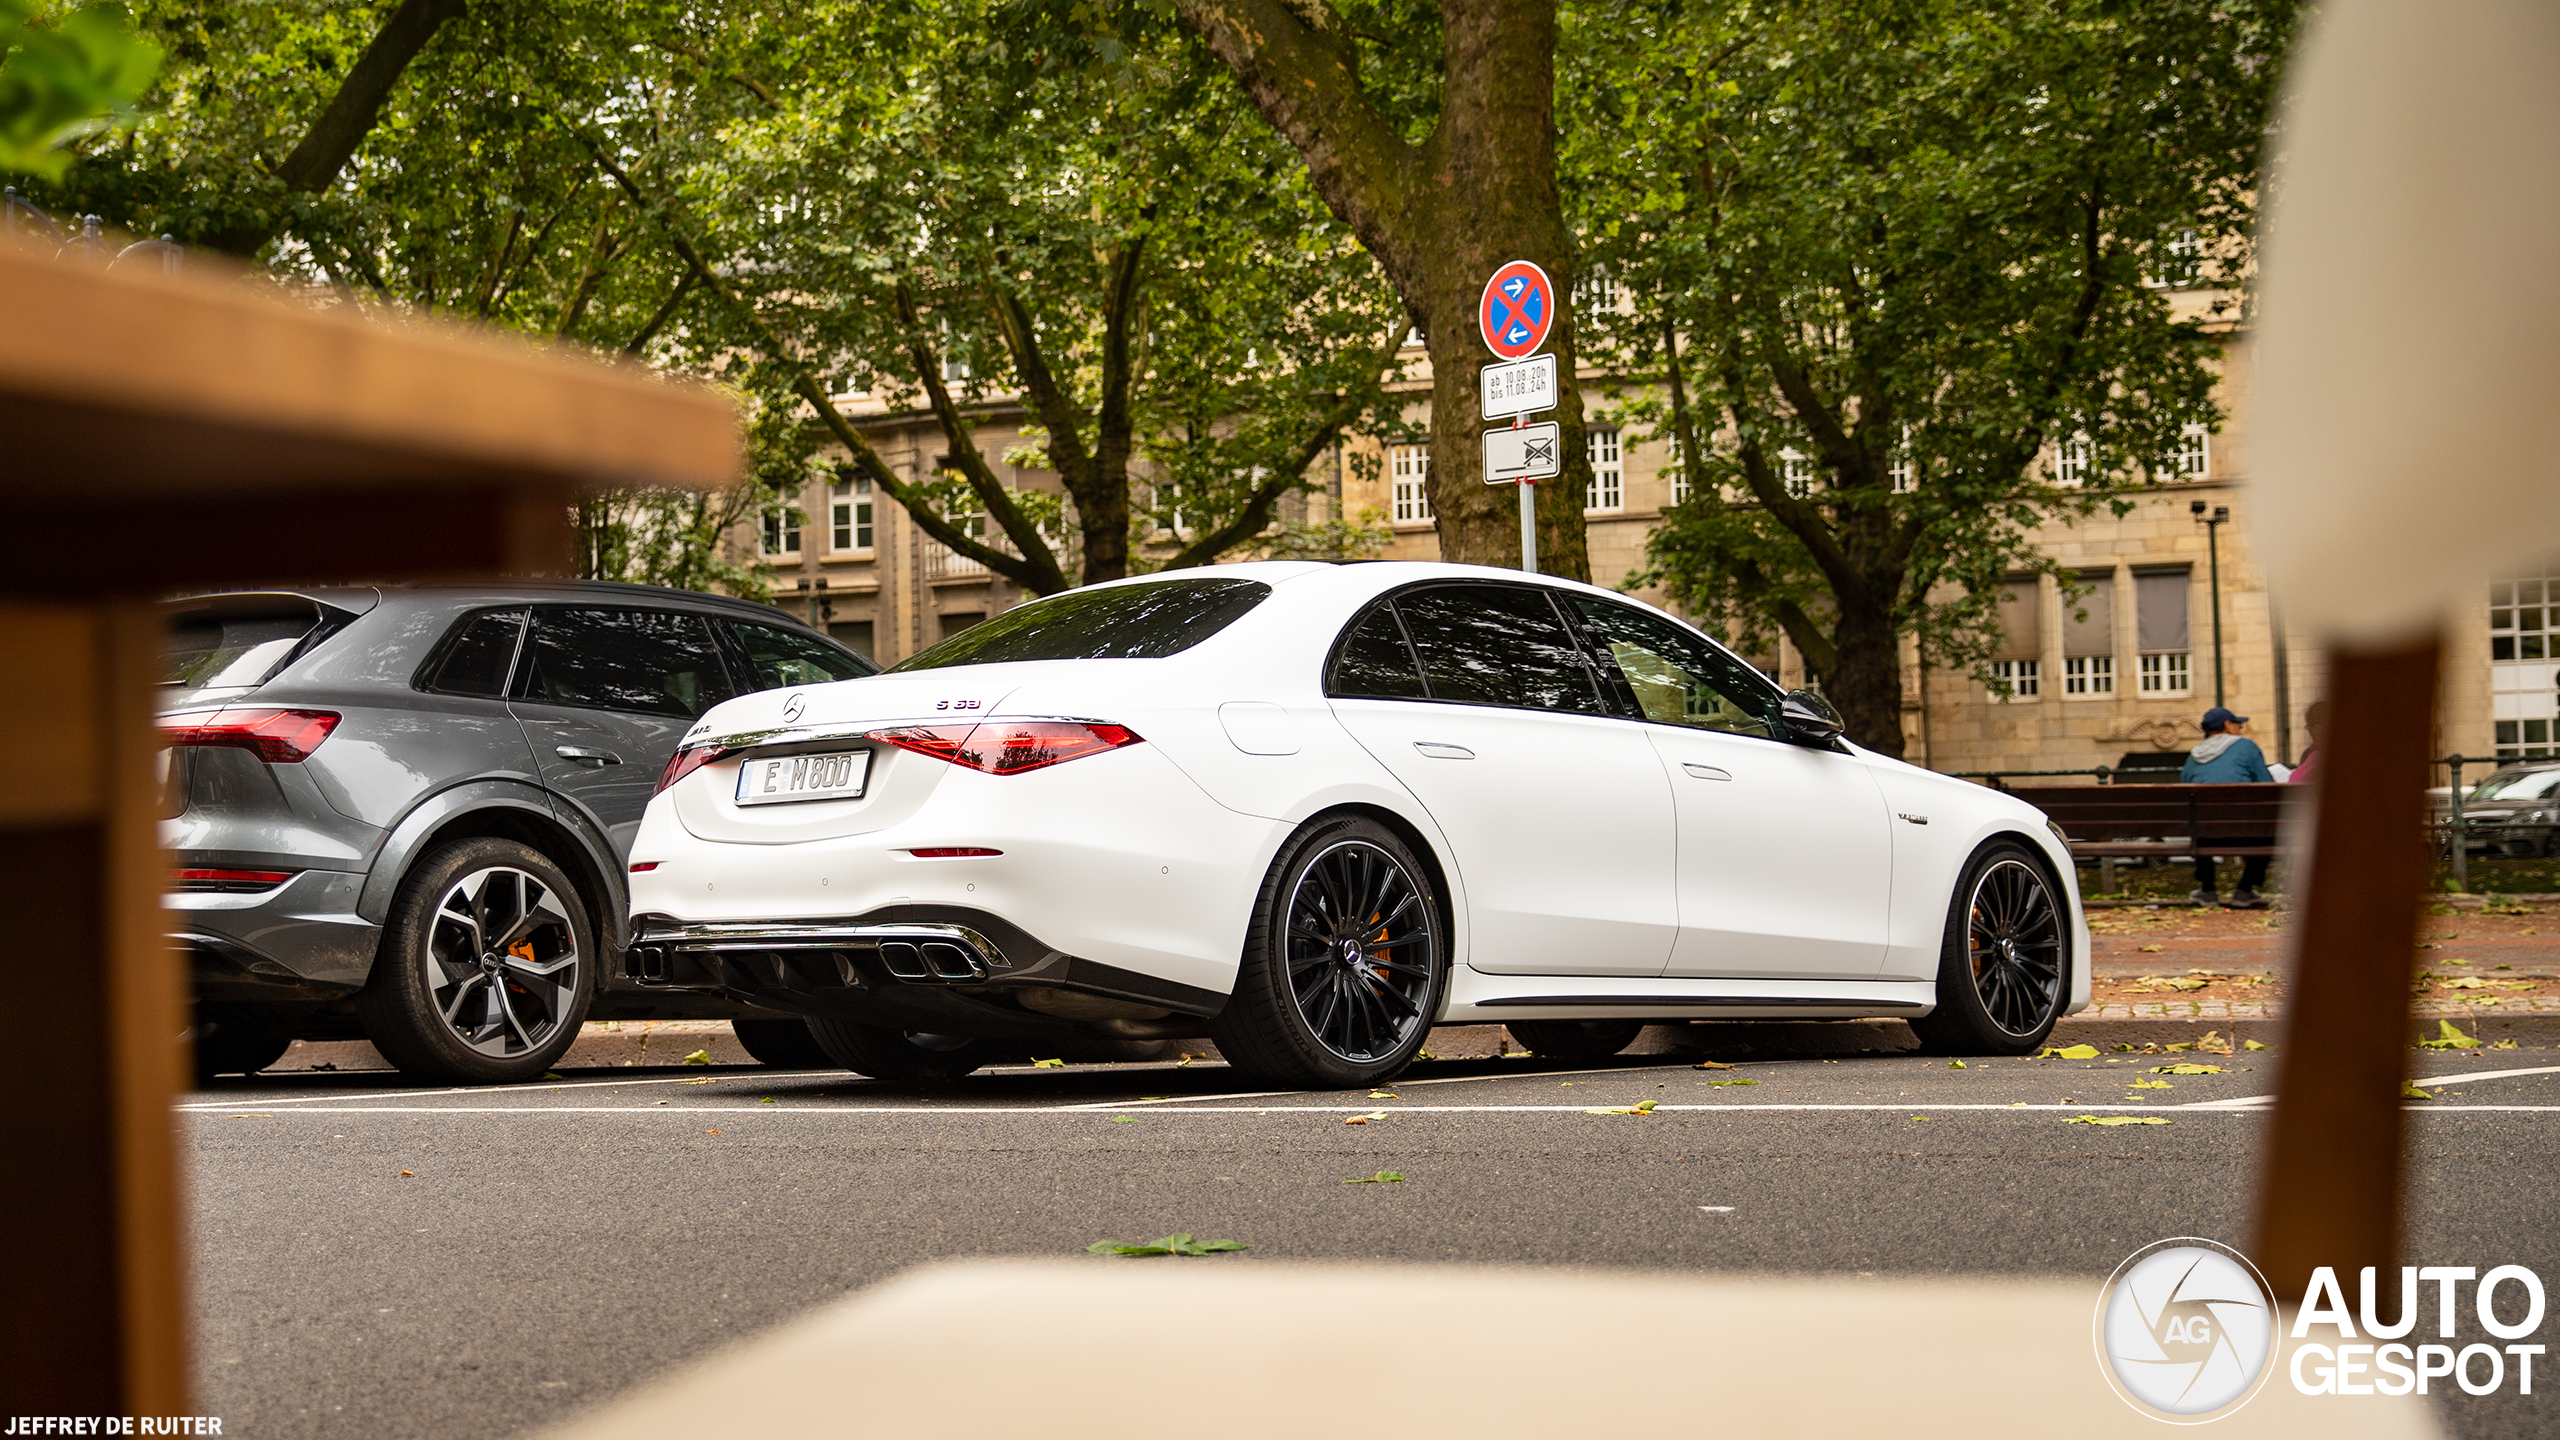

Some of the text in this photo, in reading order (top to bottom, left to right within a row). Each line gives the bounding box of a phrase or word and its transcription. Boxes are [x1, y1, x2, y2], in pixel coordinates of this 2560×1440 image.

[1491, 374, 1500, 387] ab
[1490, 387, 1503, 400] bis
[936, 699, 982, 711] S 63
[764, 761, 780, 793] E
[1278, 998, 1310, 1053] MICHELIN
